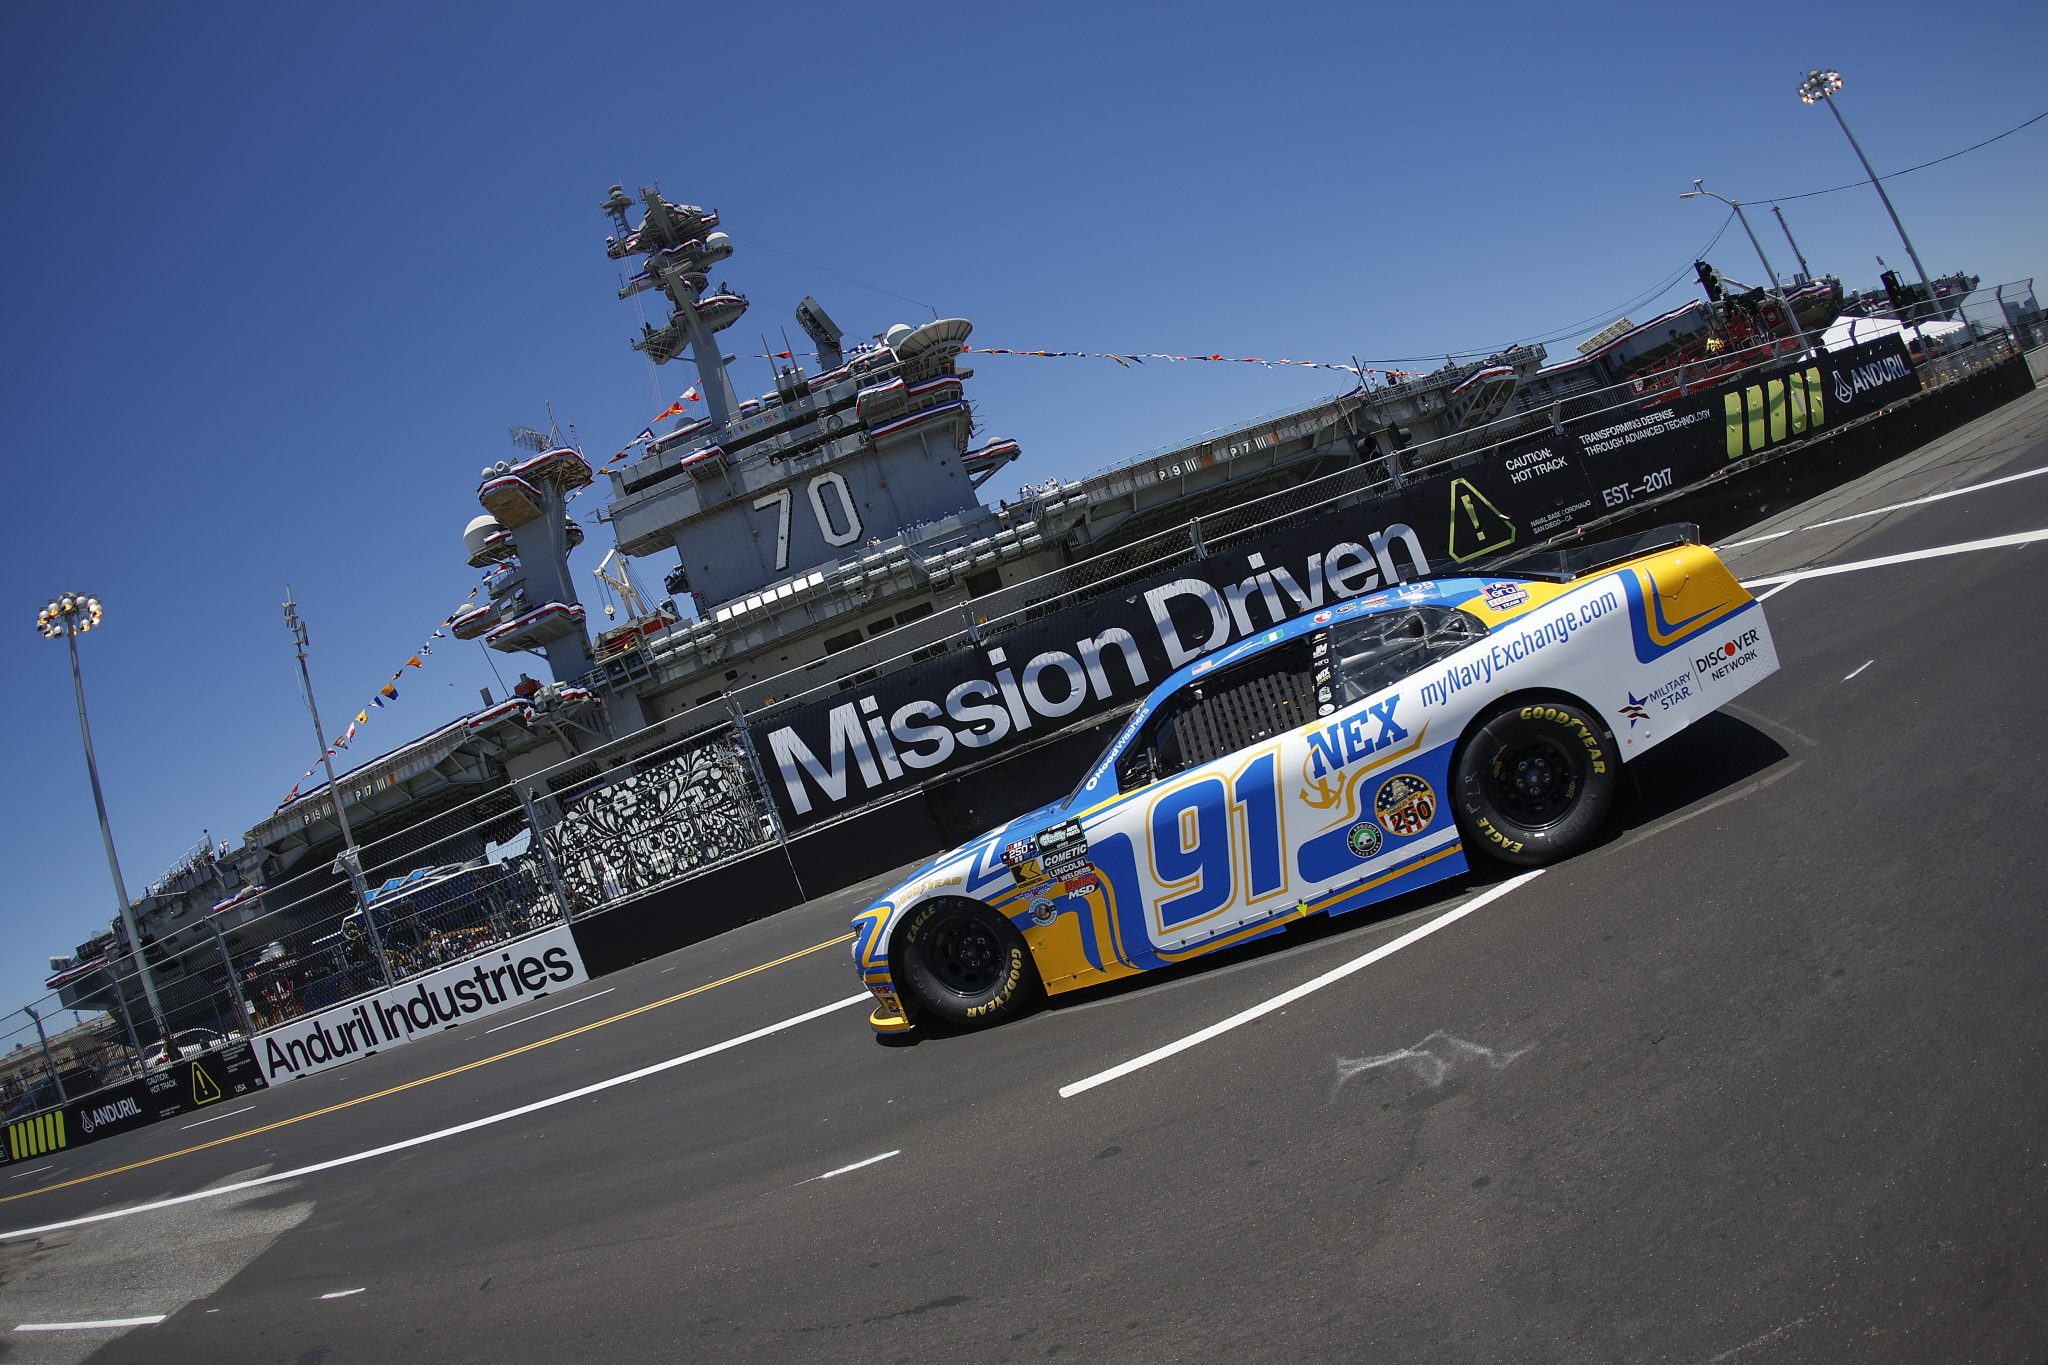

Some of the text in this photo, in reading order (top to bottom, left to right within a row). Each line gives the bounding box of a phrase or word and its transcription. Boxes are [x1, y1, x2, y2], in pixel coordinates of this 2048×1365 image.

[1851, 354, 1911, 394] ANDURIL
[1579, 409, 1675, 445] TRANSFORMING DEFENSE
[1584, 409, 1711, 457] THROUGH ADVANCED TECHNOLOGY
[1506, 447, 1553, 471] CAUTION:
[1511, 456, 1568, 484] HOT TRACK
[753, 471, 864, 571] 70
[1530, 500, 1591, 527] NAVAL BASE CORONADO
[1533, 525, 1545, 535] SAN
[1491, 586, 1516, 598] era
[1420, 590, 1618, 707] myNavyExchange.com
[1696, 629, 1760, 673] DISCOVER
[768, 523, 1431, 814] Mission Driven
[1711, 649, 1757, 681] NETWORK
[1649, 671, 1691, 702] MILITARY
[1661, 686, 1691, 710] STAR
[1307, 694, 1408, 779] NEX
[1520, 706, 1605, 775] GOODYEAR
[1389, 800, 1432, 832] 250
[1147, 745, 1288, 935] 91
[1476, 817, 1525, 854] EAGLE
[1009, 845, 1028, 859] 250
[1044, 844, 1087, 867] COMETIC
[1050, 859, 1085, 877] LINCOLN
[1060, 866, 1092, 881] WELDERS
[1068, 885, 1095, 900] MSD
[907, 904, 936, 944] EAGLE
[967, 949, 1022, 1018] GOODYEAR
[266, 947, 574, 1078] Anduril Industries
[150, 1079, 178, 1094] HOT TRACK
[234, 1083, 247, 1093] USA
[93, 1097, 142, 1127] ANDURIL
